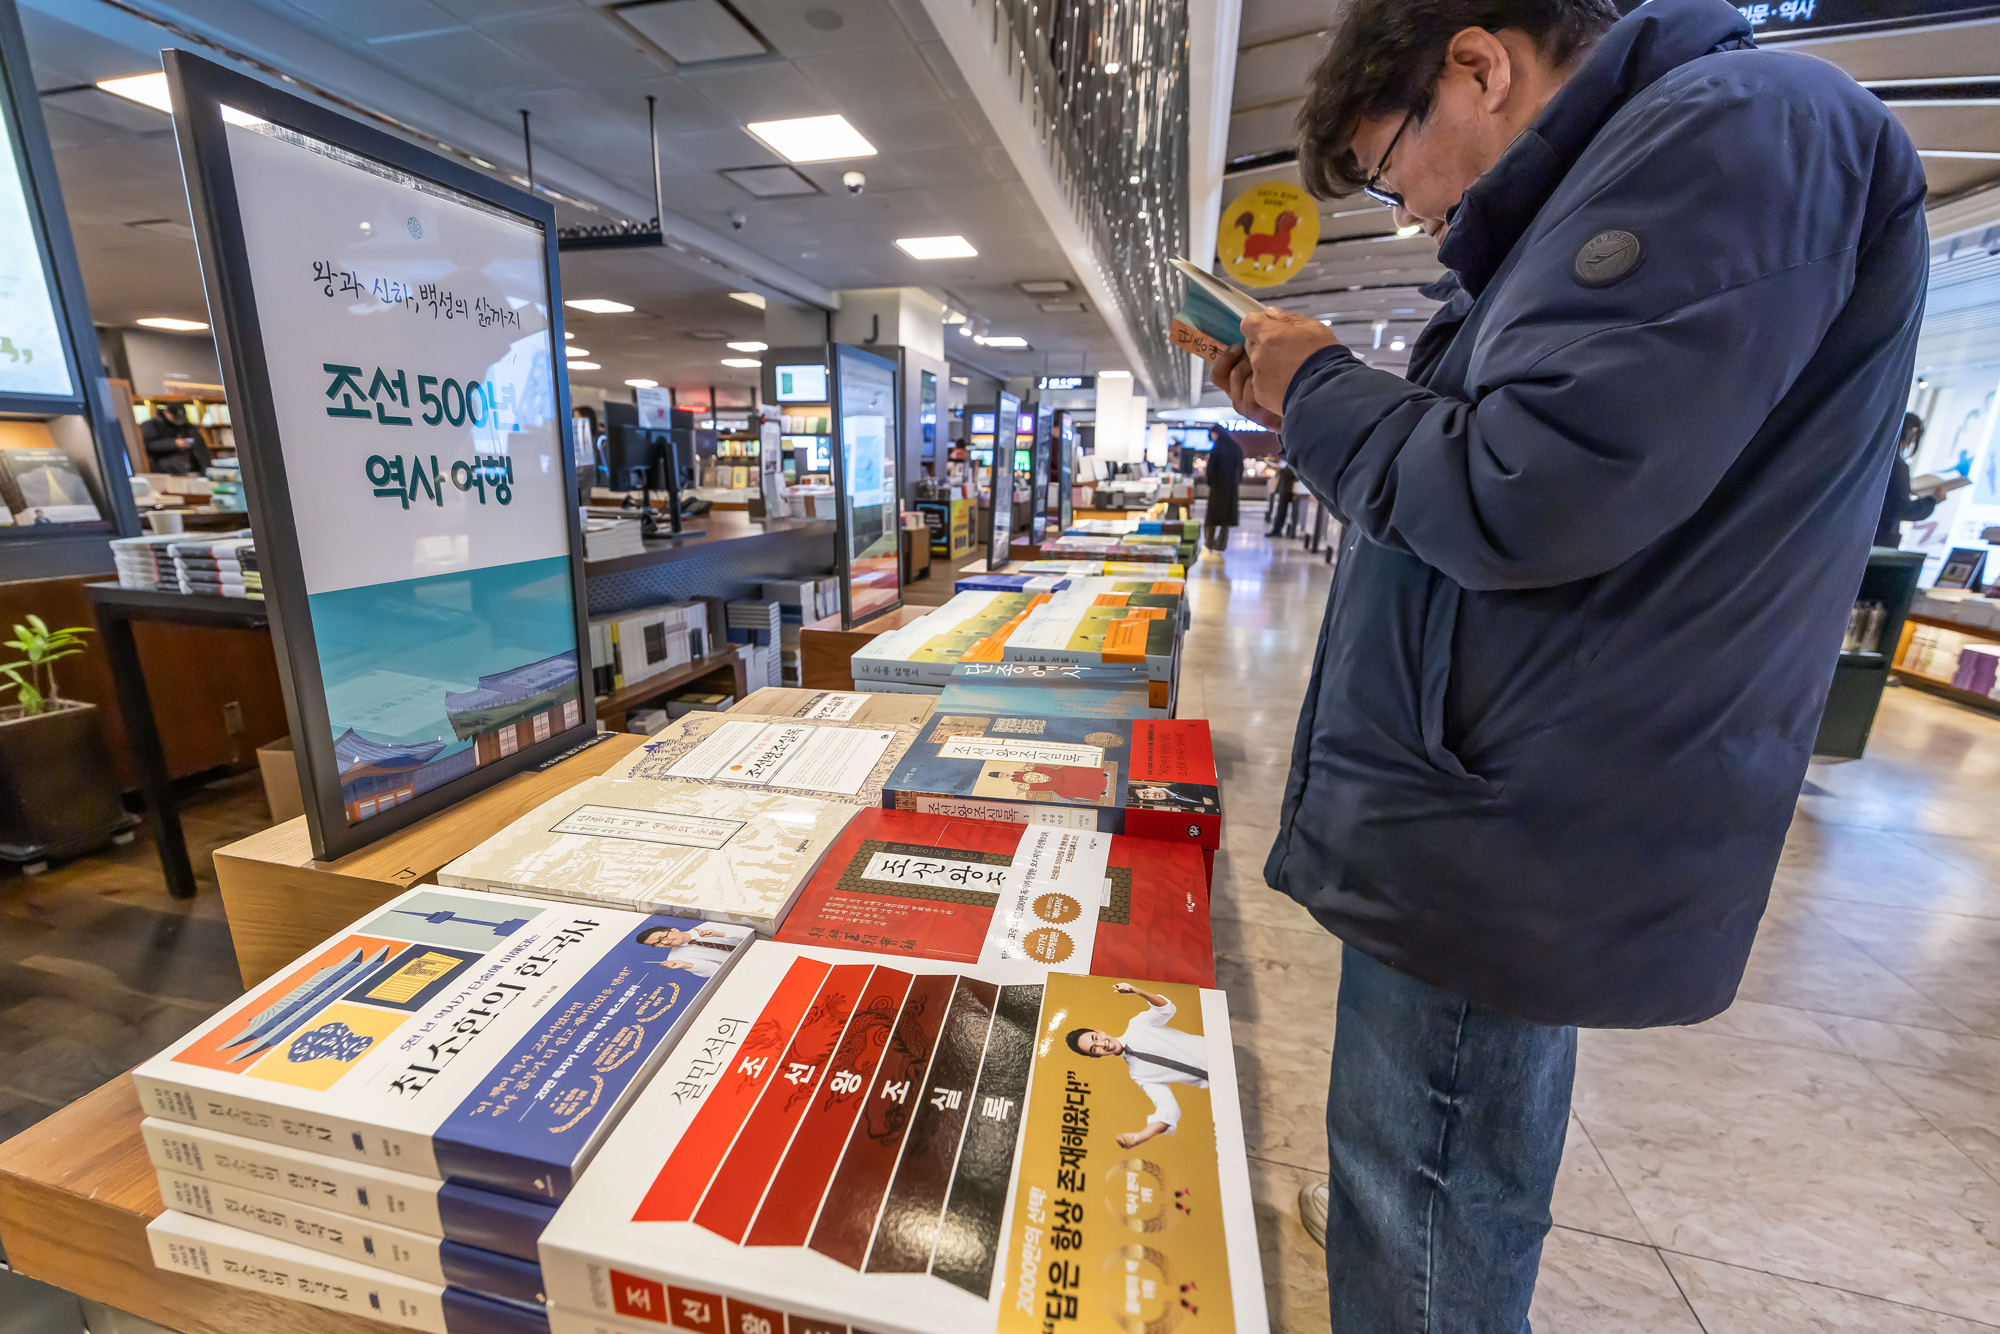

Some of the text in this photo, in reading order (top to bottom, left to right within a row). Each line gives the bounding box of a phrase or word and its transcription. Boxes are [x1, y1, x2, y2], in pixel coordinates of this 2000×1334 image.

[312, 260, 365, 298] 왕과
[420, 283, 468, 319] 백성의
[475, 297, 521, 330] 삶까지
[863, 313, 879, 344] J
[322, 362, 520, 432] 조선 500년
[365, 454, 514, 510] 역사 여행
[861, 665, 919, 677] 나 사용 설명서
[964, 663, 1092, 679] 단종애사
[744, 727, 805, 779] 조선왕조실록
[952, 745, 1083, 762] 조선왕조실록
[928, 802, 1020, 821] 조선왕조실록
[1034, 933, 1048, 954] 2017년
[1044, 930, 1059, 959] 전면개정판
[387, 918, 600, 1100] 최소한의 한국사
[399, 934, 540, 1051] 5천 년 역사가 단숨에 이해되는
[488, 1076, 514, 1097] 책이
[509, 1054, 534, 1074] 역사
[531, 1001, 584, 1052] 교과서였다면
[491, 1093, 518, 1117] 역사
[513, 1060, 547, 1092] 공부가
[541, 1048, 558, 1059] 더
[554, 1028, 577, 1046] 쉽고
[533, 984, 640, 1100] 20만 독자가 선택한 역사 베스트셀러
[670, 1016, 750, 1106] 설민석의
[1056, 1070, 1092, 1193] 존재해왔다!”
[1016, 1185, 1048, 1317] 2000만의 선택!
[1051, 1198, 1085, 1251] 항상
